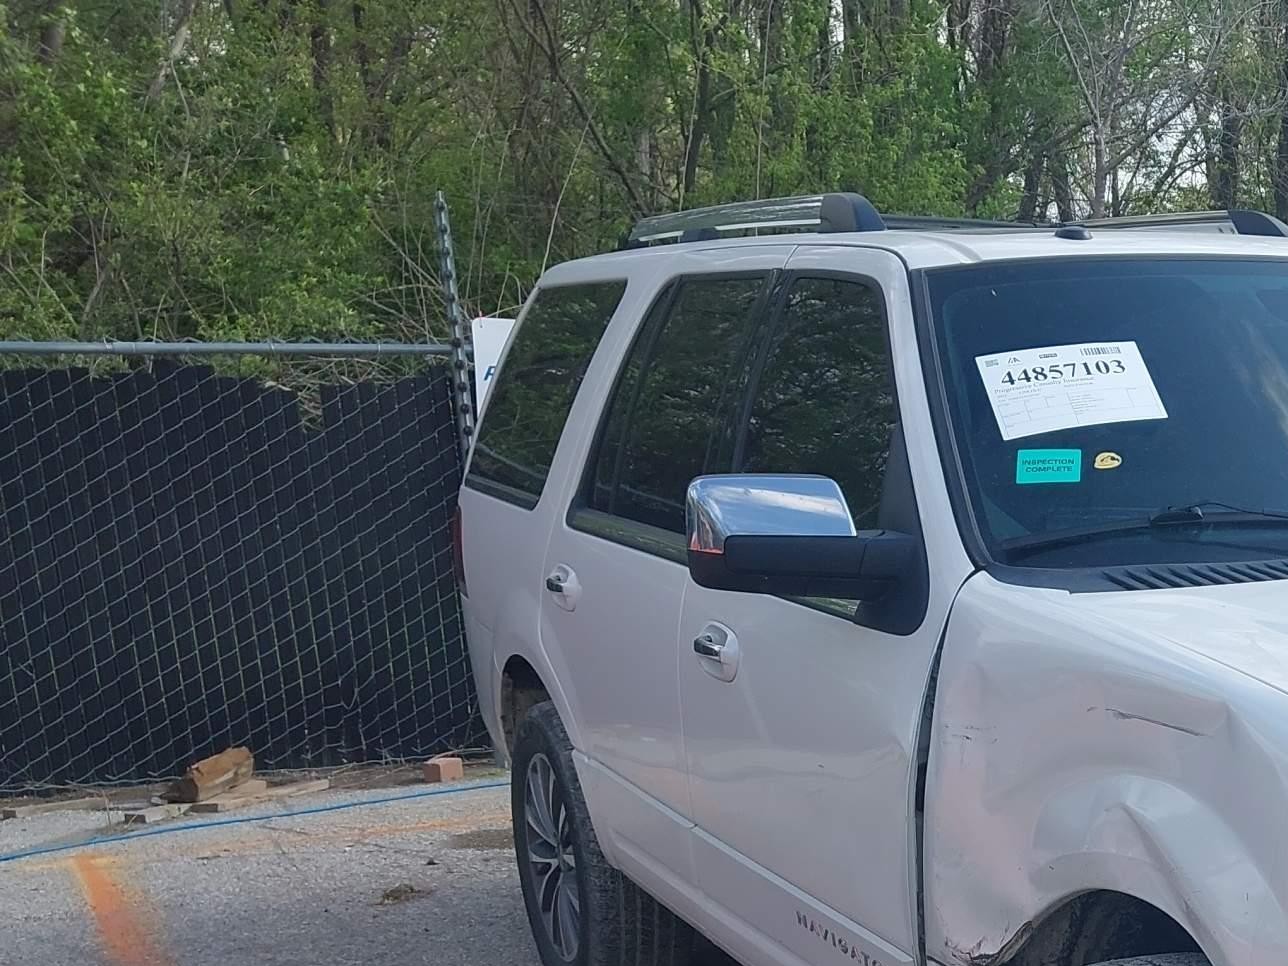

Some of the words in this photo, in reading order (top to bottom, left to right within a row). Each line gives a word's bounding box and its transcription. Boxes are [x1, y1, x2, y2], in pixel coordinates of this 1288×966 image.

[1001, 359, 1126, 386] 44857103
[1021, 457, 1075, 466] INSPECTION
[1025, 465, 1073, 473] COMPLETE
